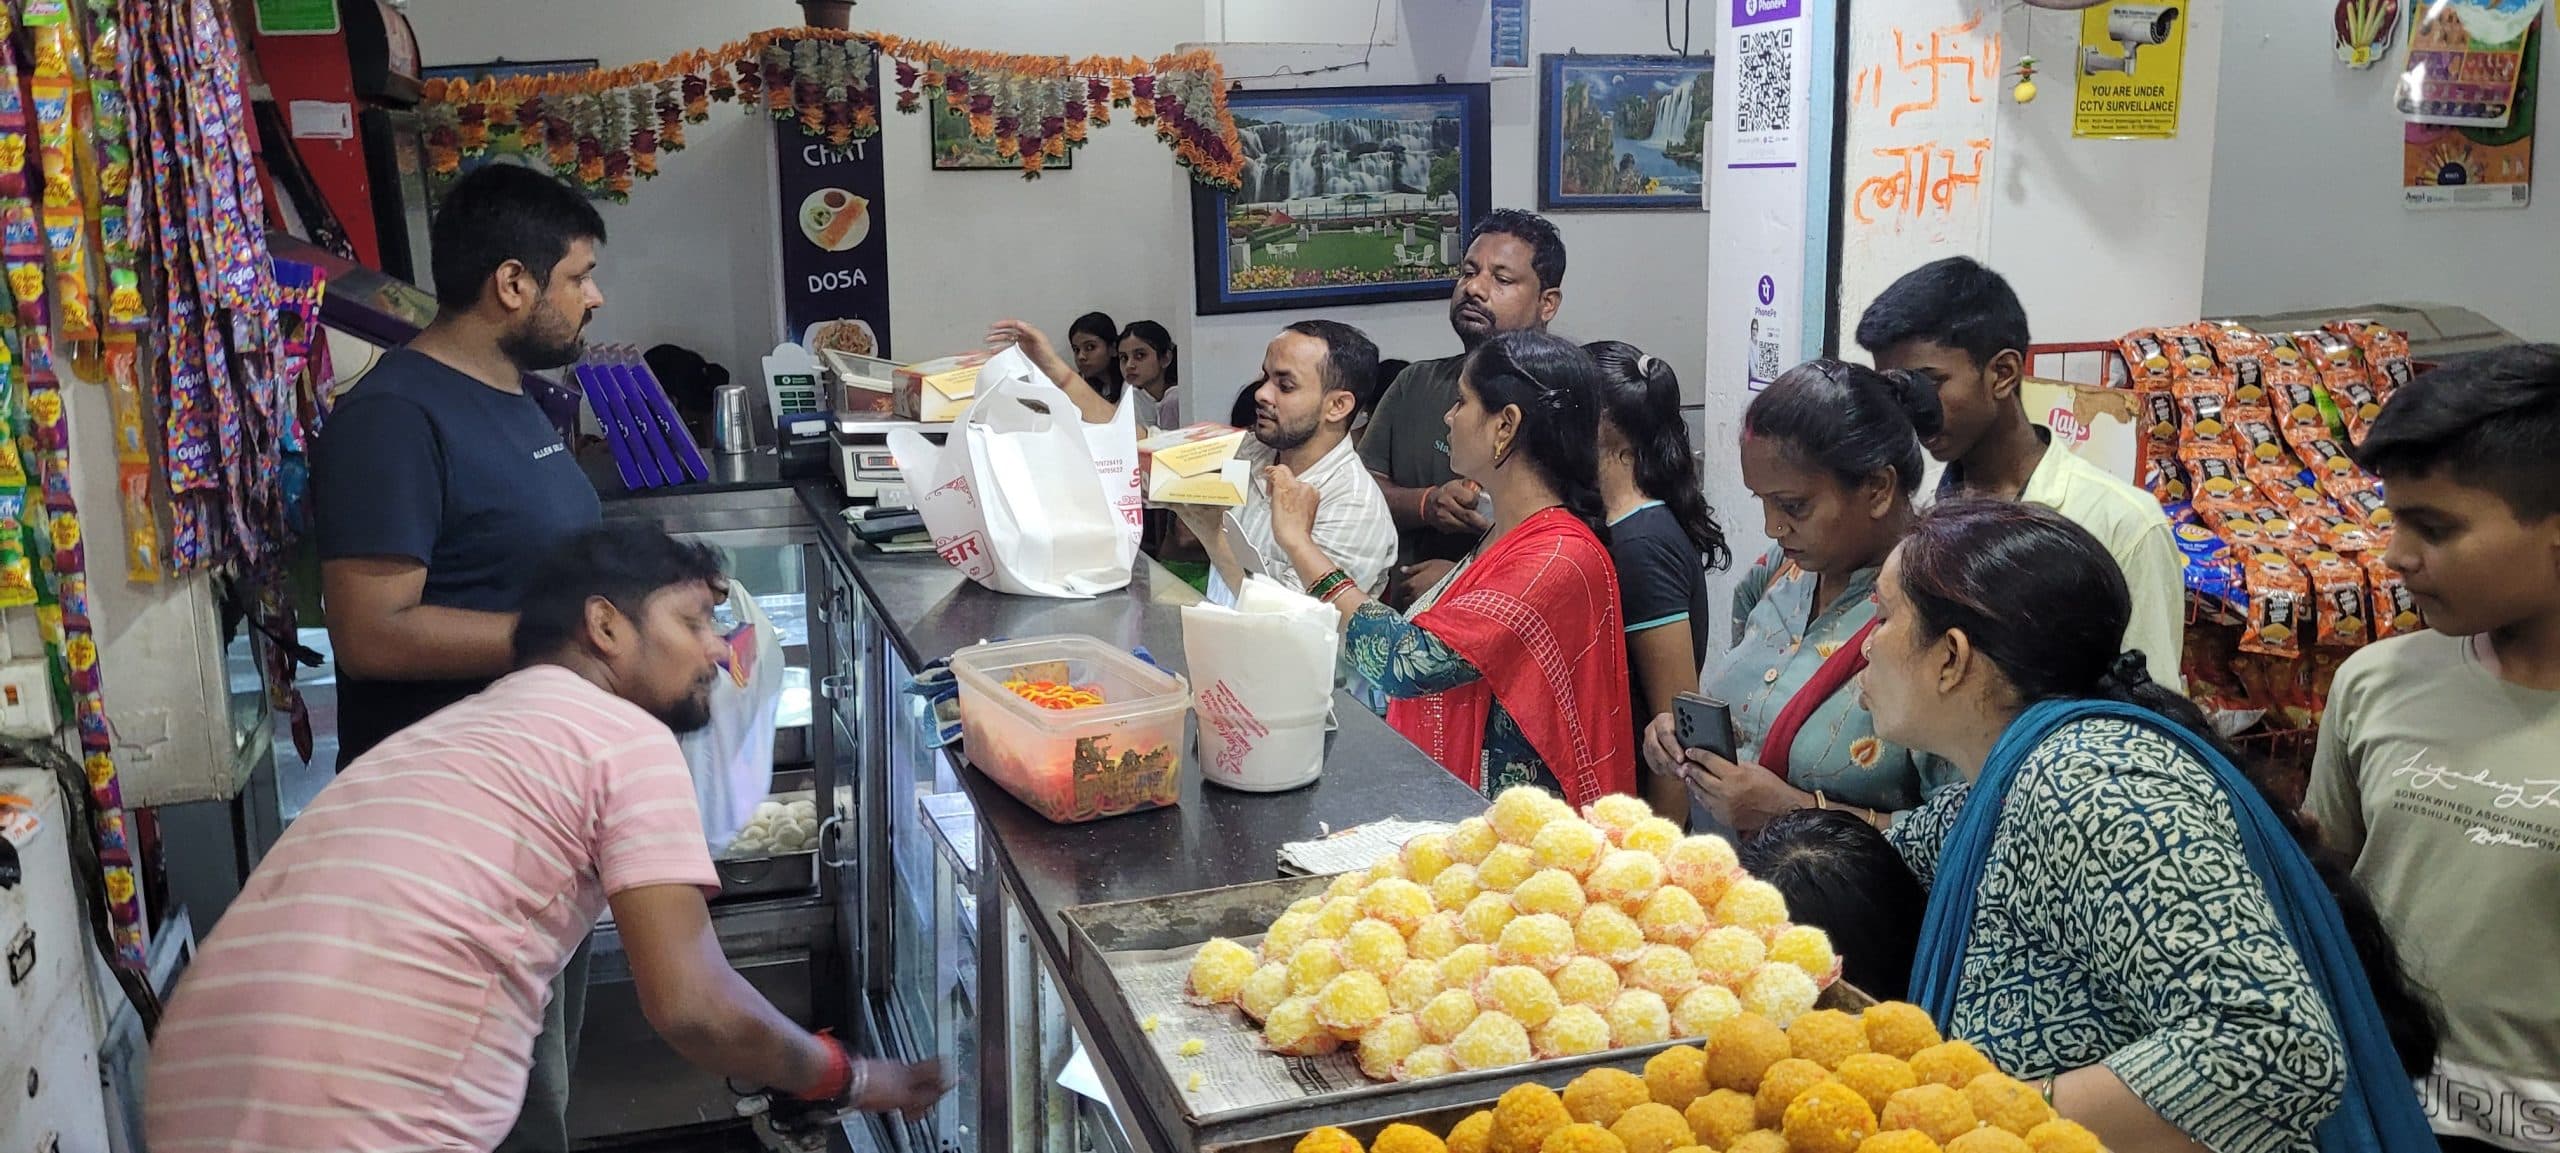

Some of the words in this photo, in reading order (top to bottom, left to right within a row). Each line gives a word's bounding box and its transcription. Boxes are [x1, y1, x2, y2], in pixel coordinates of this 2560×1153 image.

[2092, 86, 2111, 96] YOU
[2112, 86, 2131, 96] ARE
[2133, 86, 2165, 96] UNDER
[2080, 101, 2104, 112] CCTV
[2105, 101, 2174, 112] SURVEILLANCE
[808, 268, 868, 293] DOSA
[1754, 307, 1777, 318] PhonePe
[178, 441, 211, 461] GEMS
